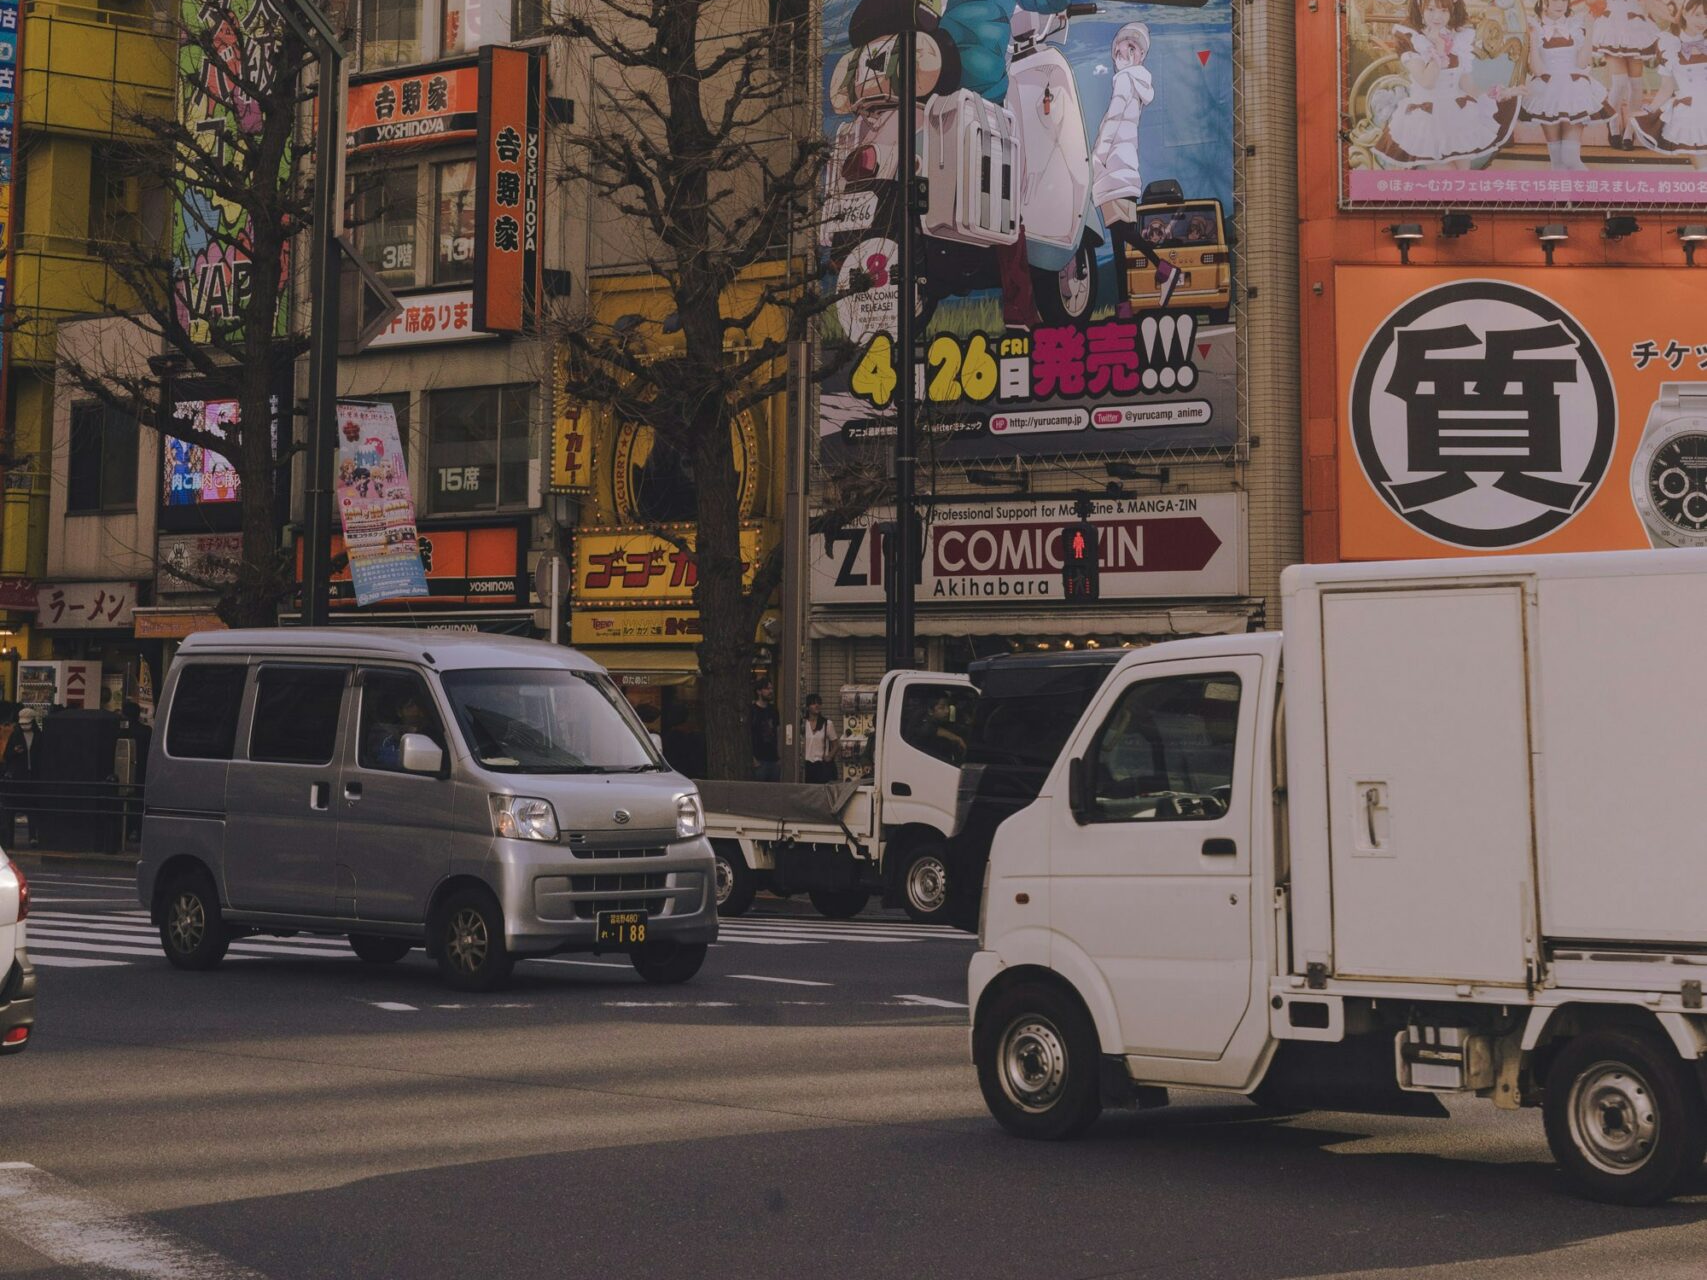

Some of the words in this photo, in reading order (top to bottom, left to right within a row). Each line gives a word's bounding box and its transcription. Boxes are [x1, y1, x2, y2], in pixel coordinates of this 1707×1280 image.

[374, 75, 449, 121] 吉野家
[376, 119, 445, 141] YOSHINOYA
[495, 126, 522, 253] 吉野家
[525, 133, 538, 251] YOSHINOYA
[382, 243, 413, 269] 3階
[1000, 337, 1029, 357] FRI
[995, 420, 1005, 429] HP
[1010, 416, 1082, 429] http://yurucamp.jp
[1098, 413, 1119, 423] Twitter
[1125, 407, 1204, 422] @yurucamp_anime
[1382, 321, 1592, 513] 質
[438, 467, 480, 492] 15席
[933, 508, 994, 521] Professional
[996, 506, 1039, 520] Support
[1041, 506, 1057, 517] for
[1058, 502, 1113, 516] Mazine
[1116, 502, 1124, 514] &
[1127, 499, 1198, 513] MANGA-ZIN
[937, 527, 1065, 571] COMIC
[469, 580, 515, 593] YOSHINOYA
[933, 577, 1049, 597] Akihabara
[49, 589, 125, 623] ラーメン
